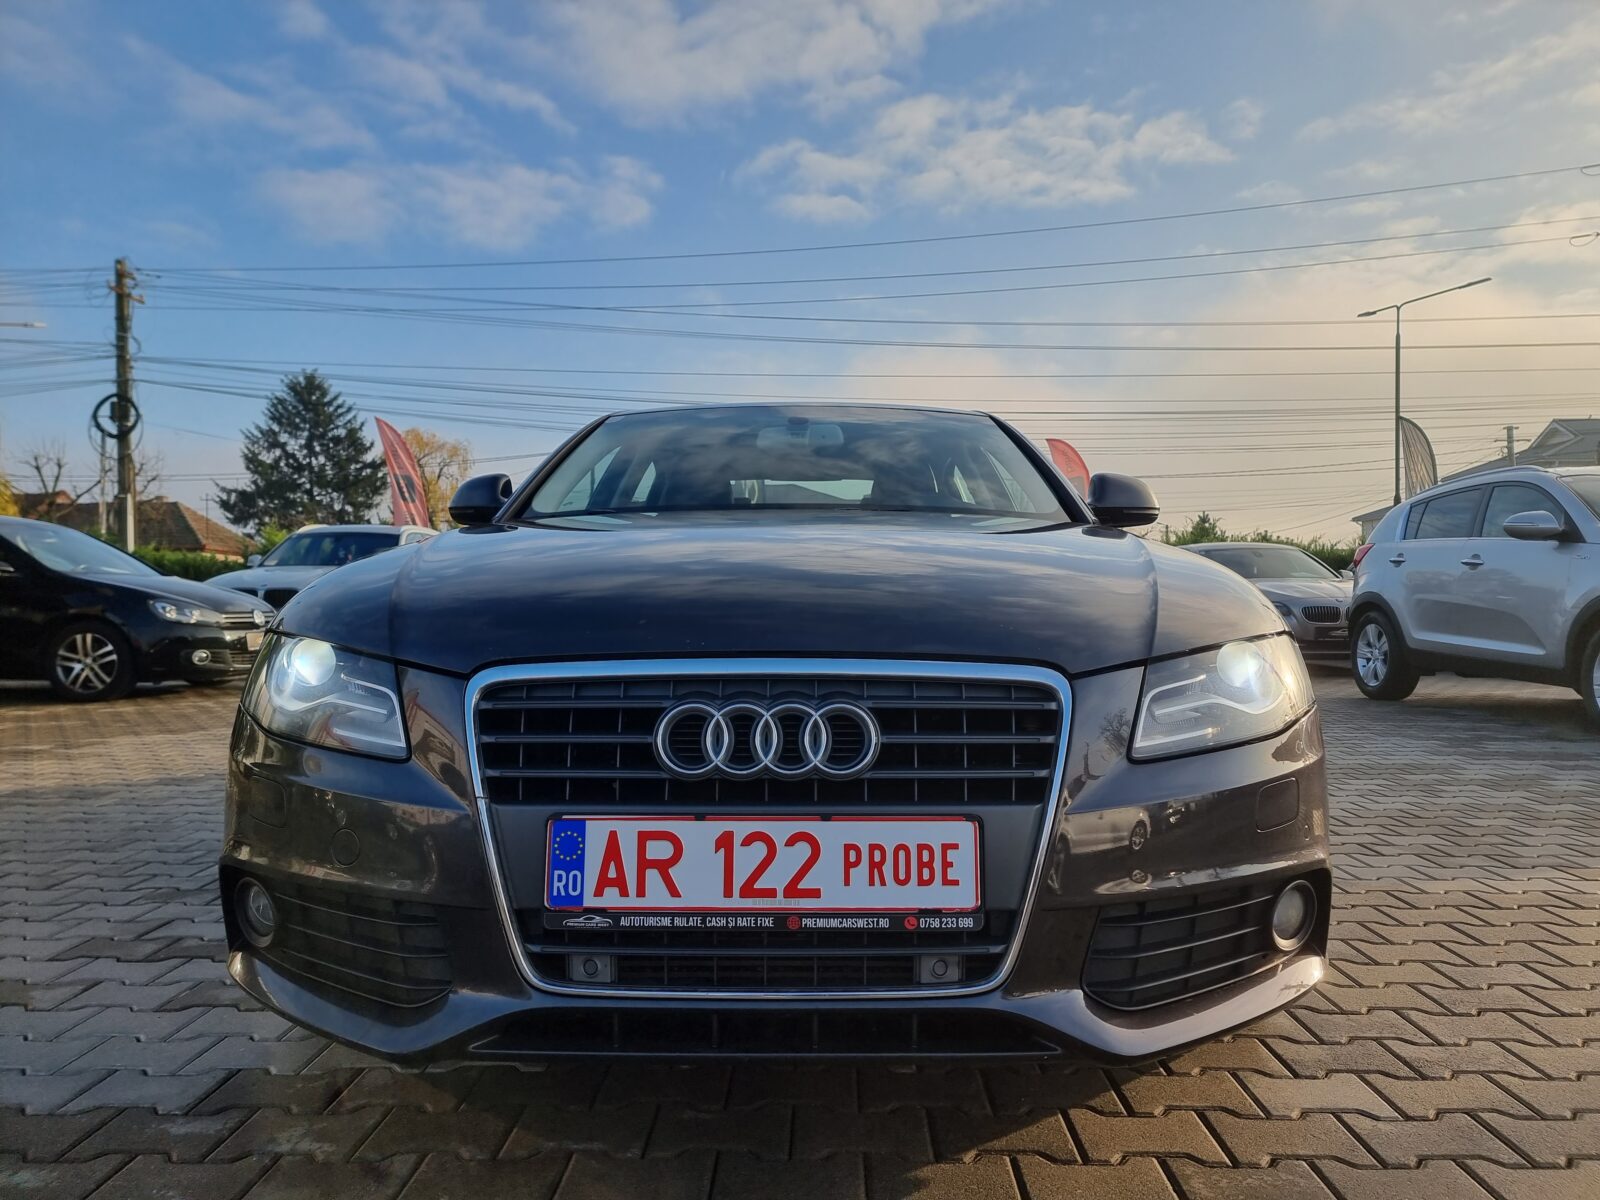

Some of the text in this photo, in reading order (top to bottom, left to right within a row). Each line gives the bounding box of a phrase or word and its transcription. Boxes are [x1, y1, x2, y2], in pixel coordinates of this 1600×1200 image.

[593, 830, 960, 899] AR 122 PROBE
[553, 870, 581, 897] RO
[620, 916, 673, 927] AUTOTURISME
[674, 916, 705, 928] RULATE,
[706, 916, 726, 927] CASH
[737, 916, 756, 927] RATE
[757, 916, 775, 927] FIXE
[802, 917, 890, 929] PREMIUMCARSWEST.RO
[919, 917, 974, 928] 0758 233 699
